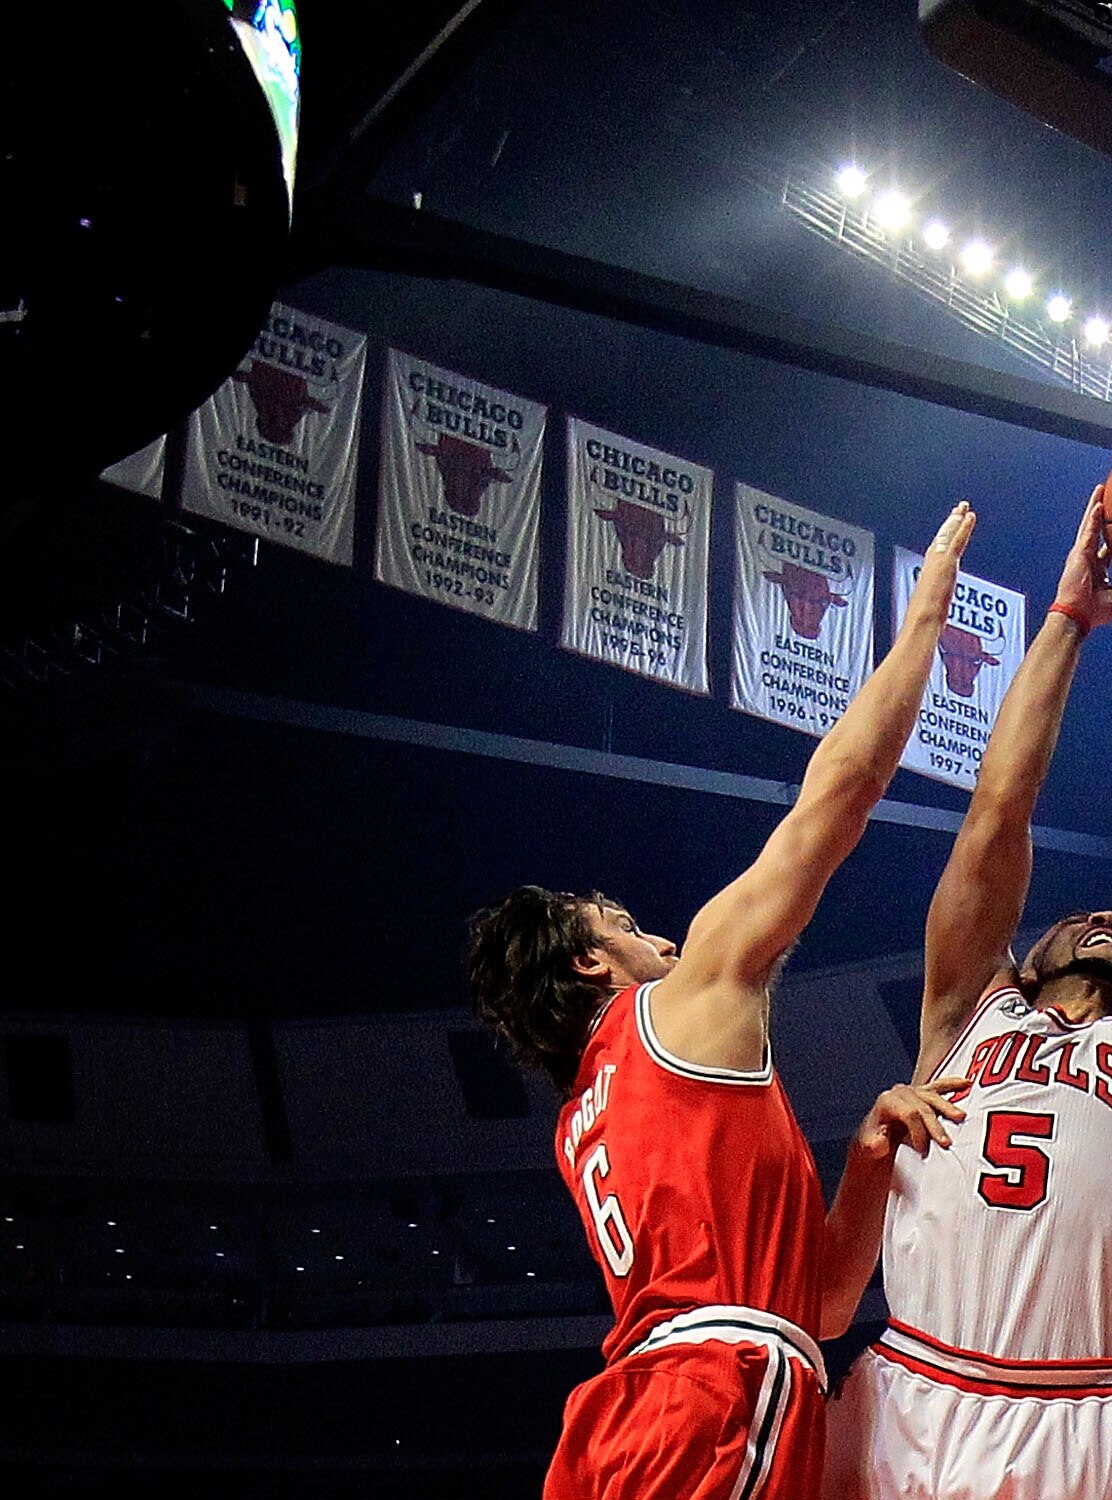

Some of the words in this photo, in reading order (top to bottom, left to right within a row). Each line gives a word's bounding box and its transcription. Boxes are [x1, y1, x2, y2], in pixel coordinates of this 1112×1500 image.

[256, 337, 326, 376] ULLS
[409, 371, 524, 430] CHICAGO
[426, 401, 508, 447] BULLS
[236, 434, 310, 473] EASTERN
[586, 438, 695, 494] CHICAGO
[217, 451, 325, 500] CONFERENCE
[604, 469, 679, 512] BULLS
[217, 474, 322, 521] CHAMPIONS
[412, 523, 511, 568] CONFERENCE
[429, 507, 498, 543] EASTERN
[754, 504, 856, 557] CHICAGO
[413, 546, 510, 590] CHAMPIONS
[771, 531, 841, 574] BULLS
[606, 570, 669, 603] EASTERN
[591, 587, 684, 630] CONFERENCE
[592, 607, 681, 650] CHAMPIONS
[948, 603, 996, 634] ULLS
[602, 632, 667, 667] 1995-96
[776, 635, 835, 668] EASTERN
[761, 651, 850, 693] CONFERENCE
[762, 672, 849, 713] CHAMPIONS
[919, 709, 991, 744] CONFEREN
[933, 693, 990, 725] EASTERN
[978, 1110, 1055, 1212] 5
[582, 1143, 635, 1278] 6
